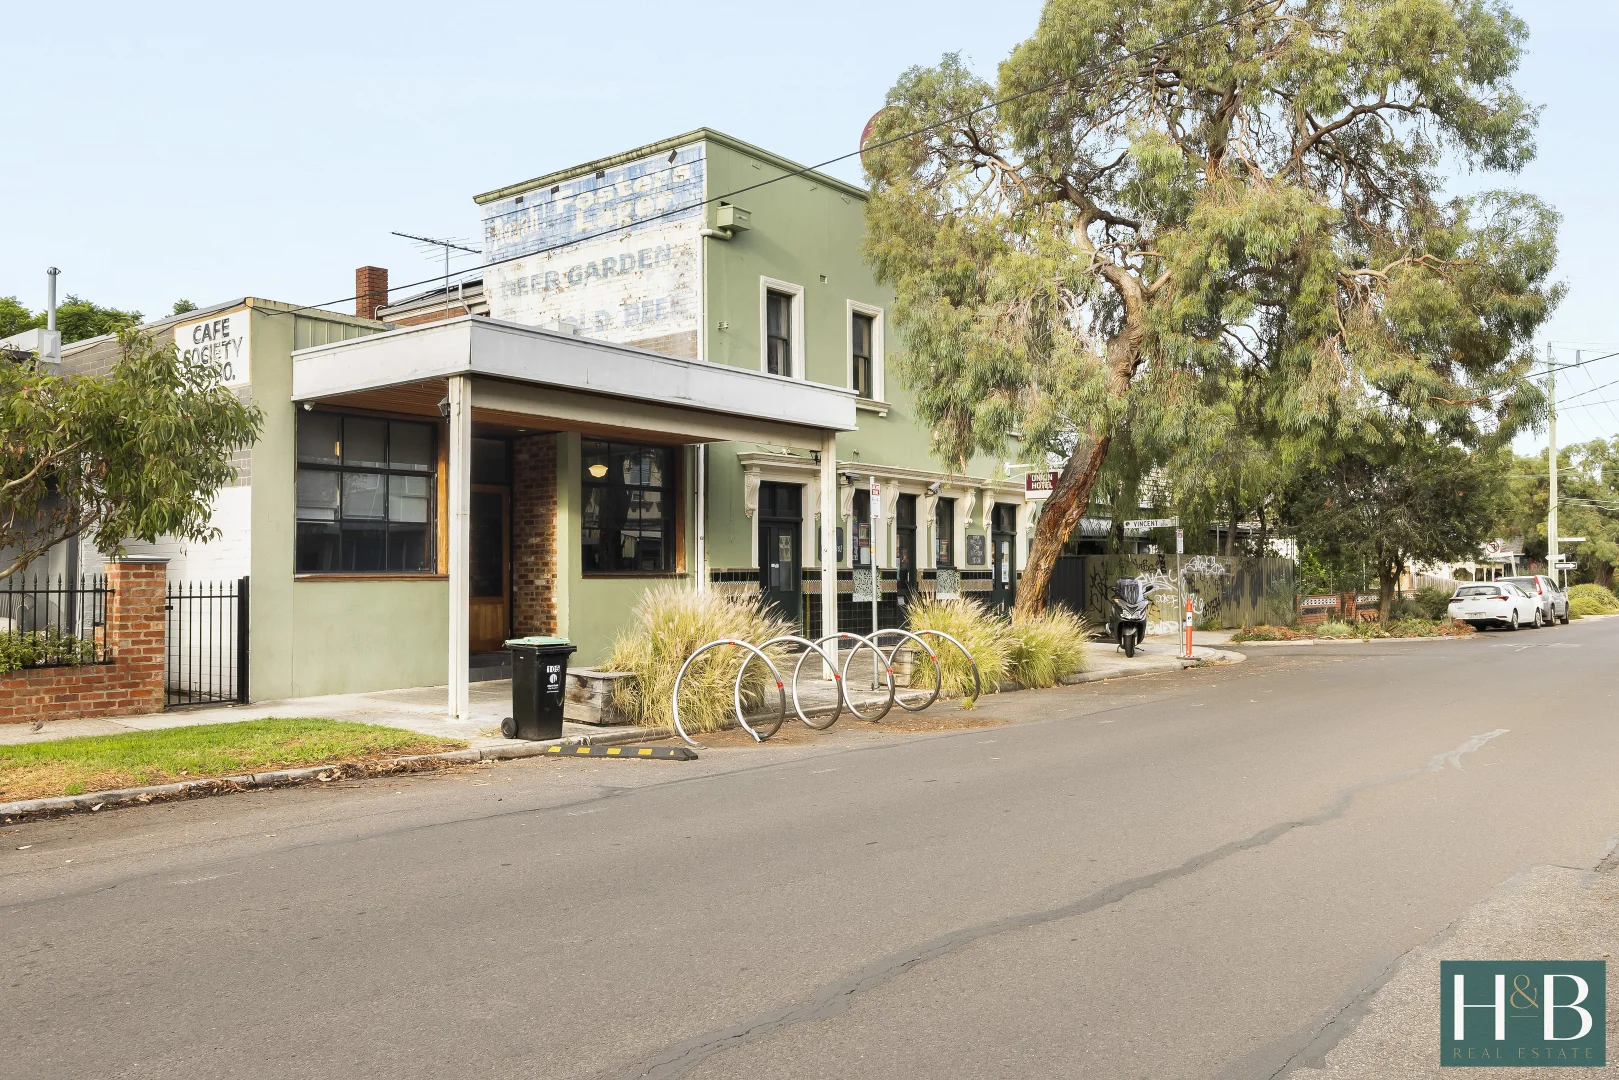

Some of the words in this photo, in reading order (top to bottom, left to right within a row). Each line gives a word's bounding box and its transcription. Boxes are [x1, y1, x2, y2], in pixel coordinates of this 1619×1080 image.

[566, 245, 673, 287] GARDEN
[192, 318, 230, 345] CAFE
[1133, 520, 1158, 528] VINCENT
